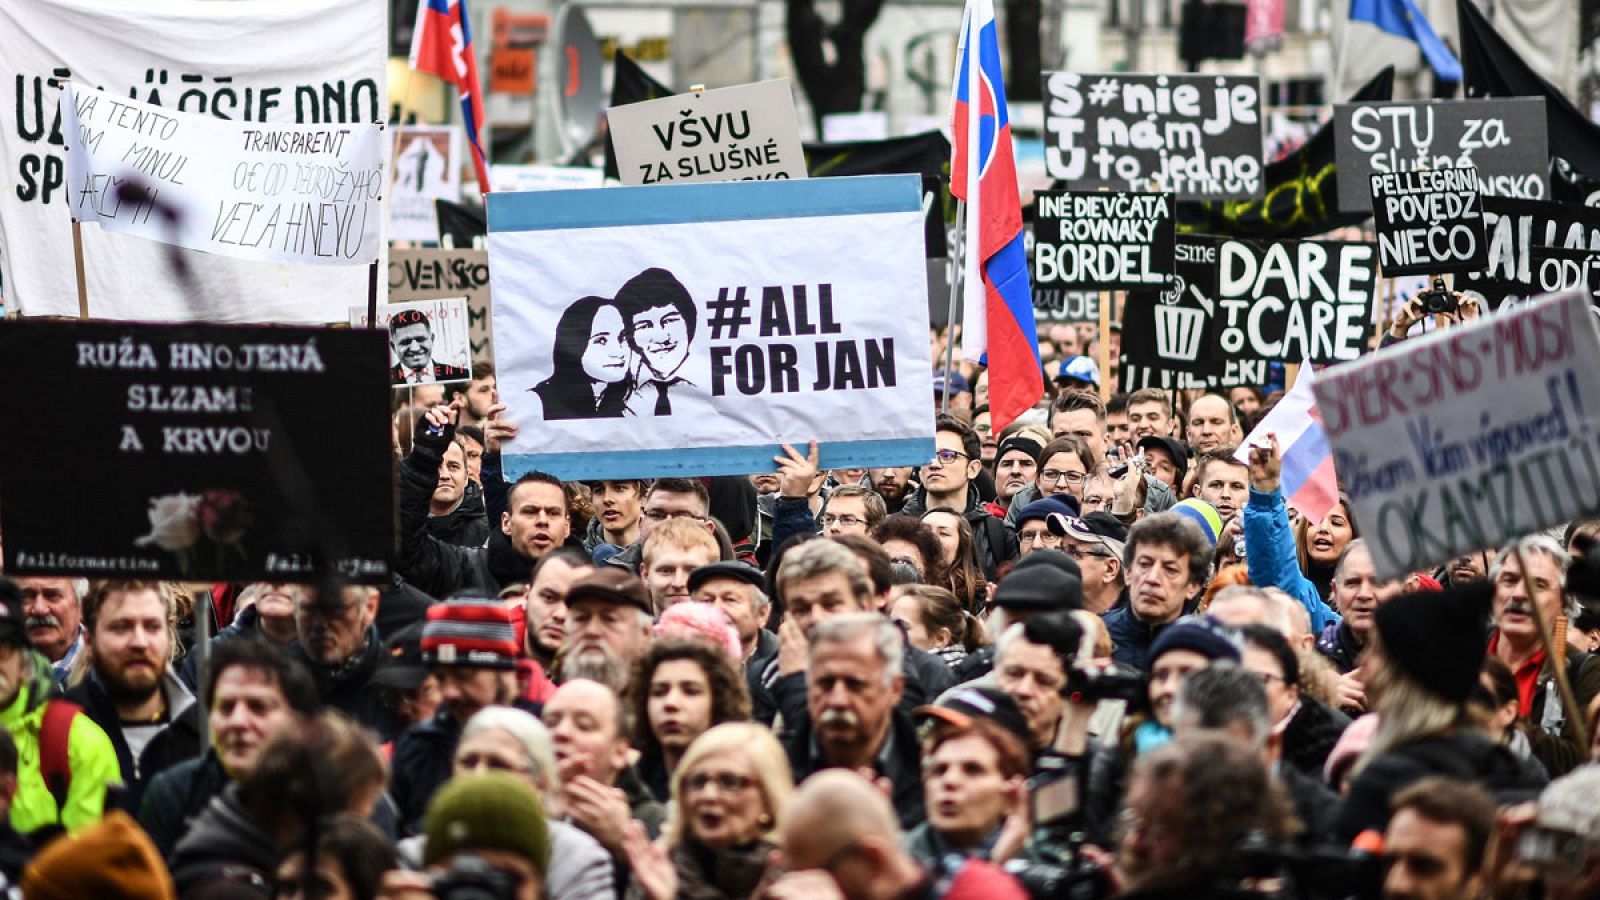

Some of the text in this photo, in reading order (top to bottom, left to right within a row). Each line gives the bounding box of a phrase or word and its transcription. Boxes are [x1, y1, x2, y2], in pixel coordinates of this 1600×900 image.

[1203, 76, 1258, 136] je
[108, 100, 180, 141] TENTO
[242, 130, 351, 158] TRANSPARENT
[652, 108, 751, 151] VŠVU
[1097, 112, 1203, 151] nám
[1351, 105, 1512, 152] STU za
[121, 142, 188, 186] MINUL
[640, 138, 780, 185] ZA SLUŠNÉ
[1092, 145, 1261, 182] to jedno
[1371, 167, 1479, 198] PELLEGRINI
[1038, 191, 1169, 219] INÉ DIEVČATÁ
[1386, 190, 1480, 224] POVEDZ
[284, 201, 367, 259] HNEVU
[1059, 217, 1159, 243] ROVNAKÝ
[1378, 221, 1477, 267] NIEČO
[1035, 242, 1174, 284] BORDEL.
[1219, 240, 1373, 304] DARE
[706, 283, 841, 341] #ALL
[1247, 297, 1365, 360] CARE
[76, 336, 325, 372] RUŽA HNOJENÁ
[710, 337, 896, 397] FOR JAN
[119, 426, 271, 453] A KRVOU
[264, 553, 388, 574] #allrjan
